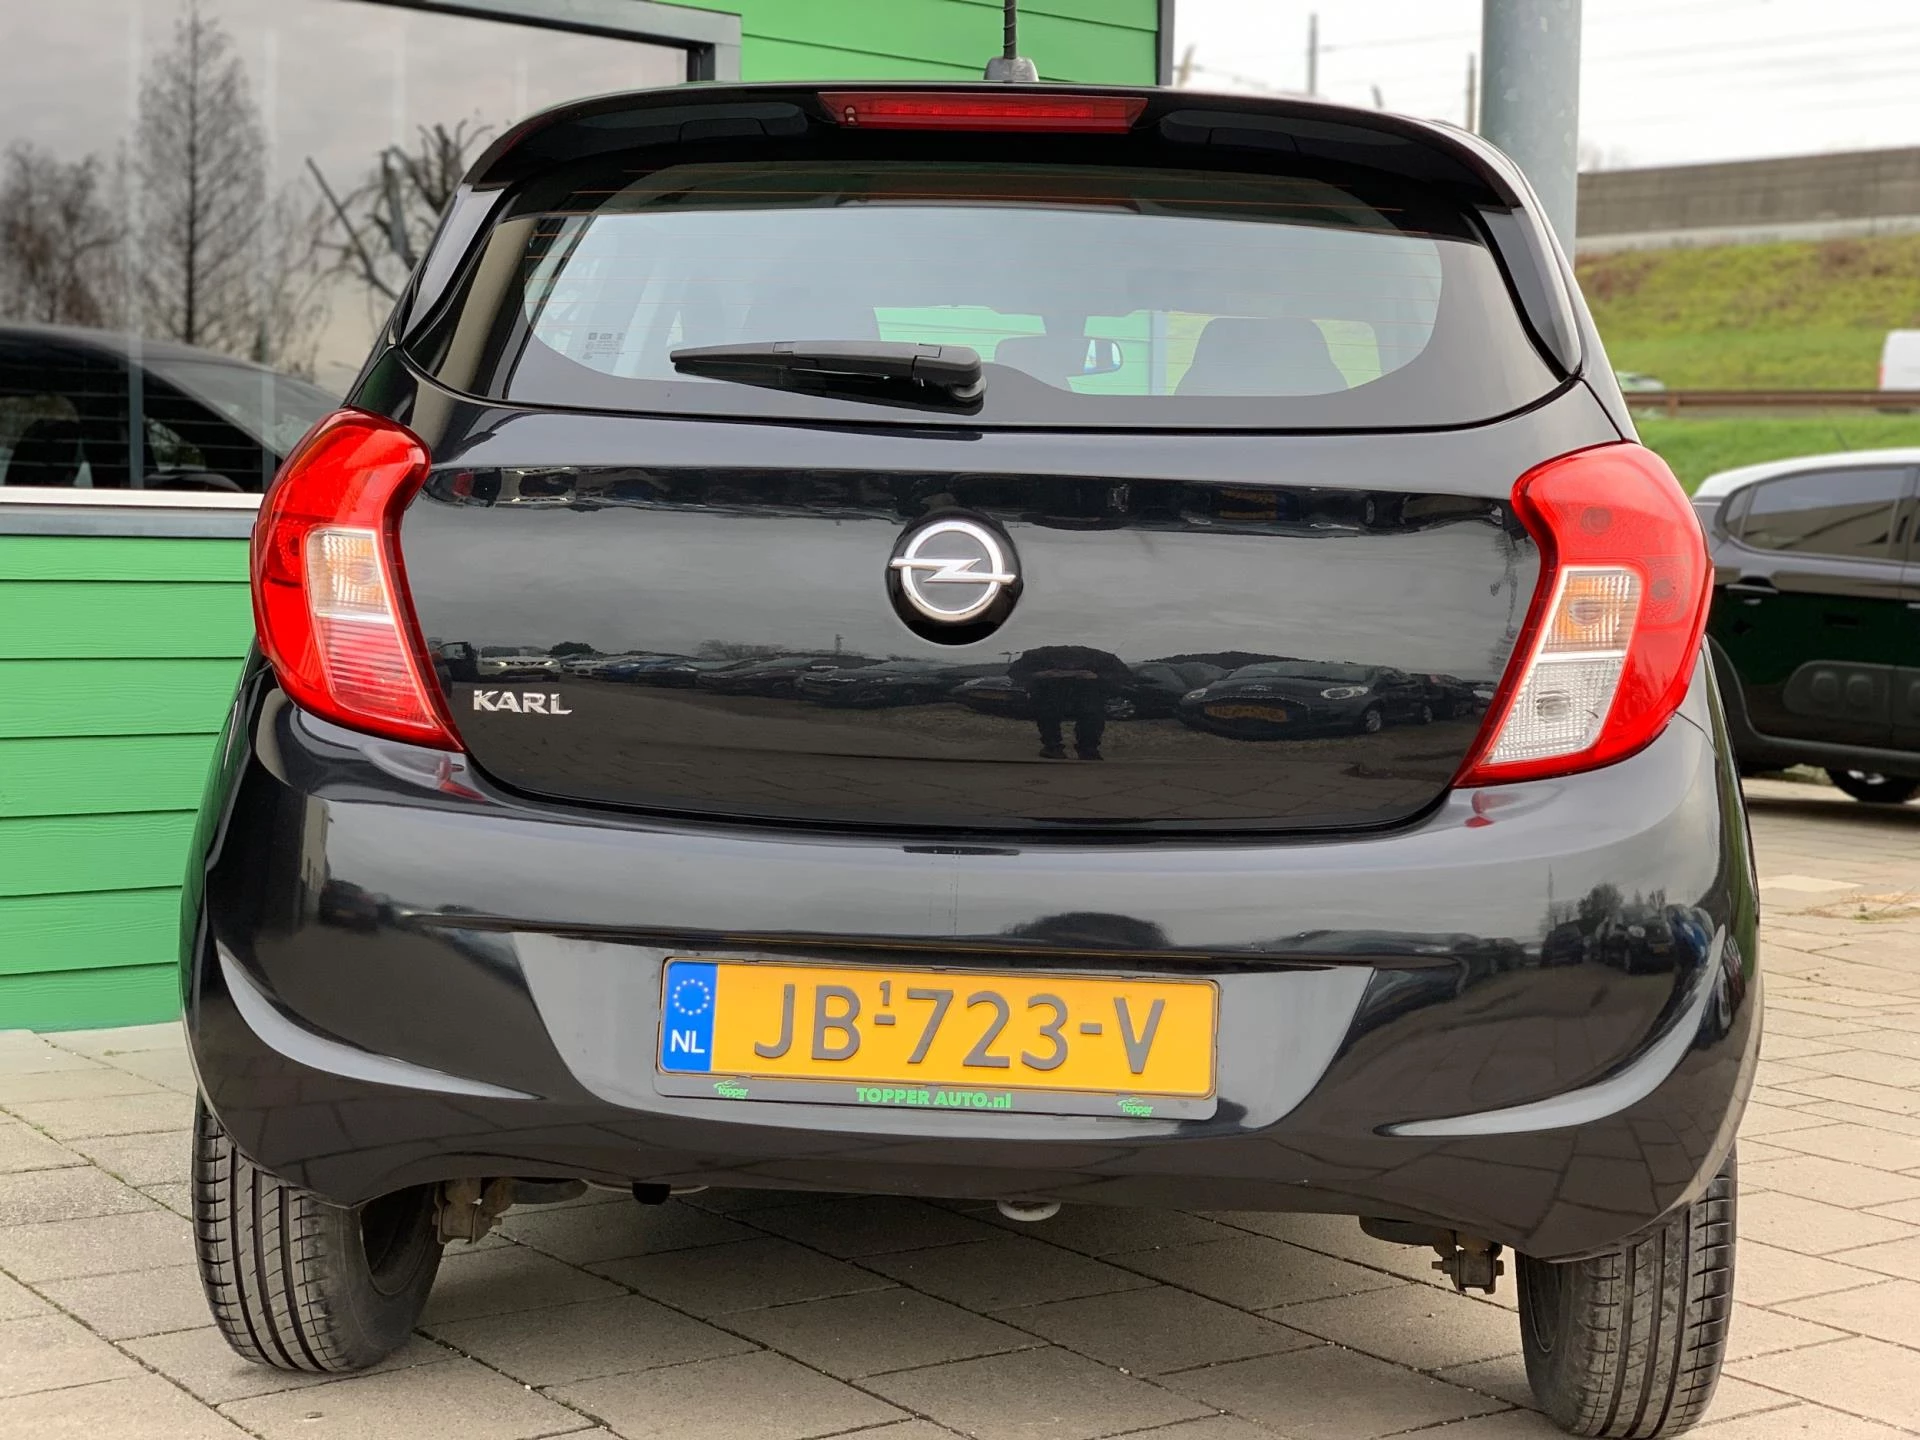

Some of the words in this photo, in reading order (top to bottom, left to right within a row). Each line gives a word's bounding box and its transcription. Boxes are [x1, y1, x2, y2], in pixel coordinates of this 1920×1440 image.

[473, 689, 573, 715] KARL
[671, 1029, 705, 1053] NL
[754, 983, 1166, 1075] JB-723-V
[856, 1088, 930, 1105] TOPPER
[933, 1091, 1012, 1108] AUTO.nl
